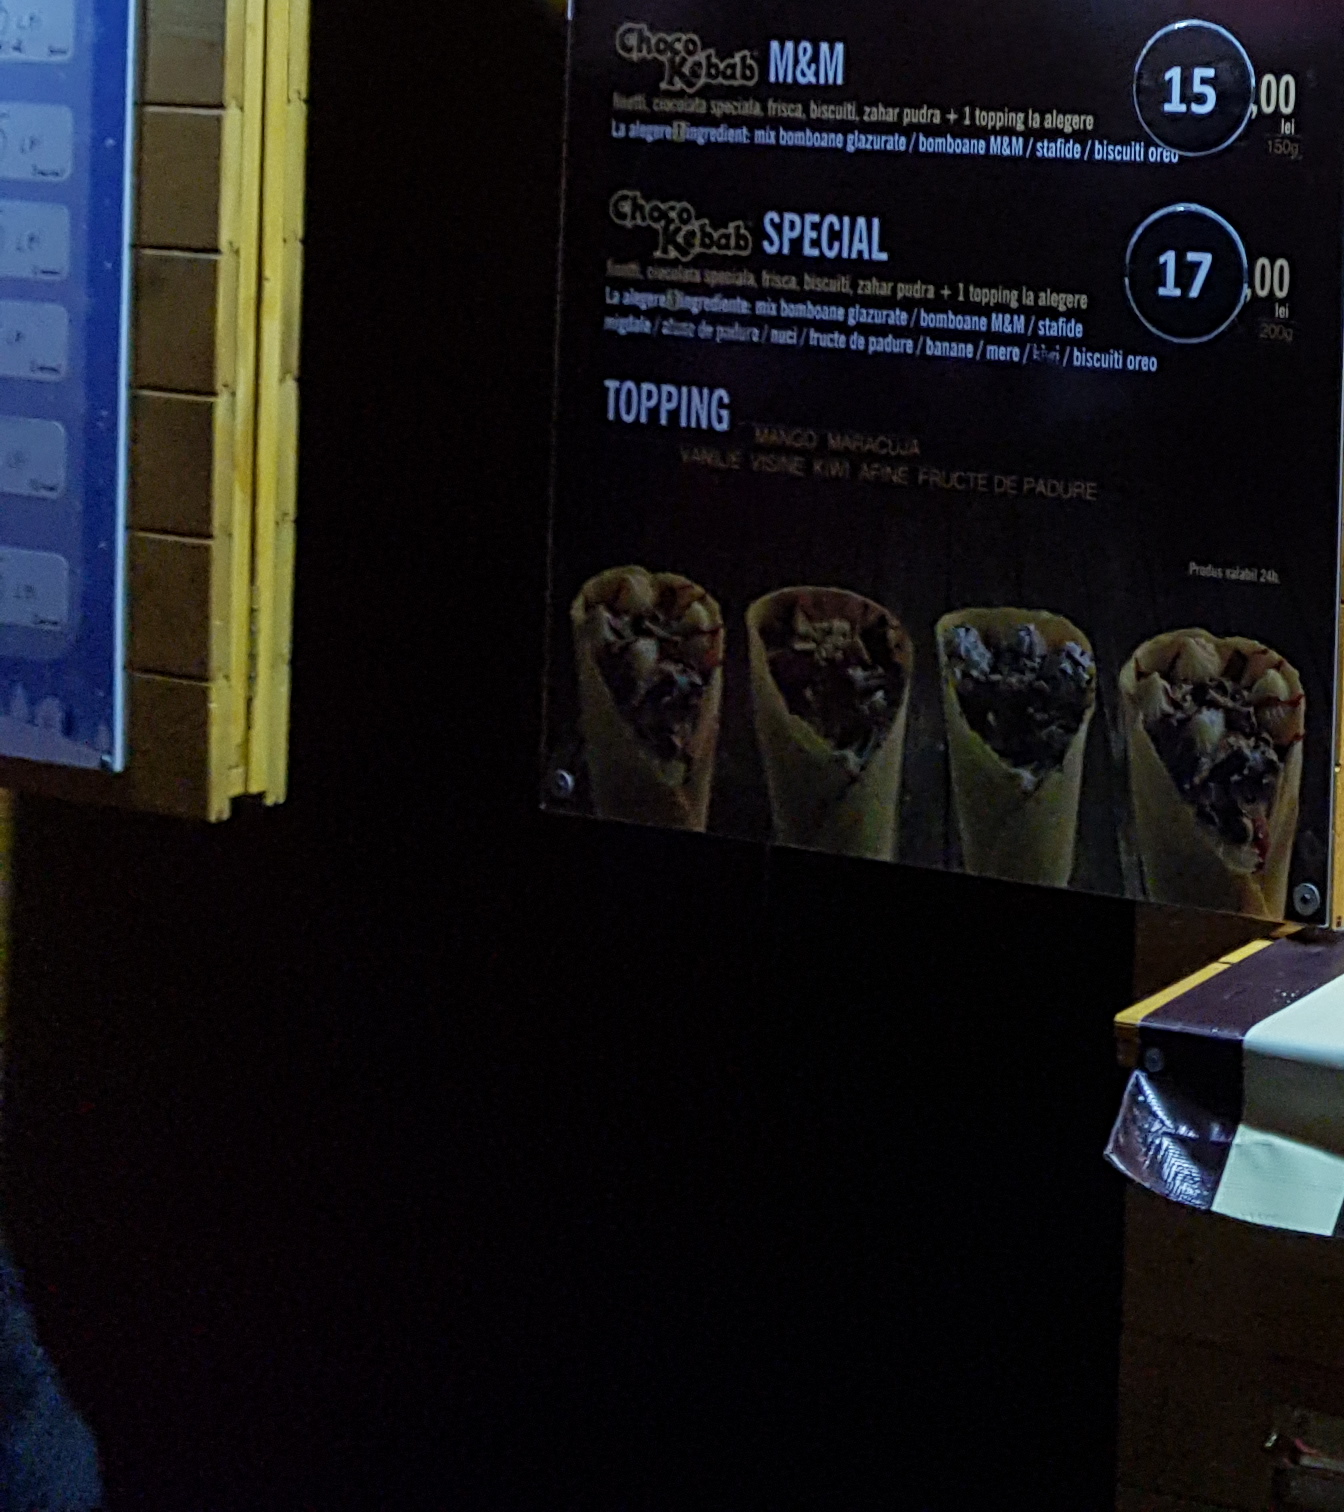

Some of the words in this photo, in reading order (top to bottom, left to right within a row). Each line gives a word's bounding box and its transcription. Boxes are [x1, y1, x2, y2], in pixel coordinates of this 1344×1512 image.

[616, 22, 702, 63] Choco
[768, 39, 845, 86] M&M
[659, 47, 759, 93] Kebab
[1163, 66, 1217, 114] 15
[1251, 73, 1296, 120] ,00
[863, 103, 901, 123] zahar
[903, 104, 941, 127] pudra
[975, 107, 1025, 131] topping
[1028, 108, 1040, 130] la
[1043, 109, 1094, 134] alegere
[1281, 118, 1295, 135] lei
[754, 126, 776, 144] mix
[918, 132, 986, 155] bomboane
[989, 135, 1024, 157] M&M
[1036, 138, 1081, 160] stafide
[1094, 139, 1144, 162] biscuiti
[609, 189, 695, 229] Choco
[653, 218, 753, 262] Kebab
[762, 210, 889, 262] SPECIAL
[1157, 249, 1213, 299] 17
[969, 283, 1019, 309] topping
[1022, 286, 1035, 307] la
[1037, 287, 1088, 312] alegere
[920, 309, 987, 332] bomboane
[991, 312, 1025, 334] M&M
[1037, 316, 1083, 338] stafide
[1072, 346, 1123, 370] biscuiti
[1126, 354, 1158, 373] oreo
[602, 378, 731, 433] TOPPING
[994, 474, 1018, 495] DE
